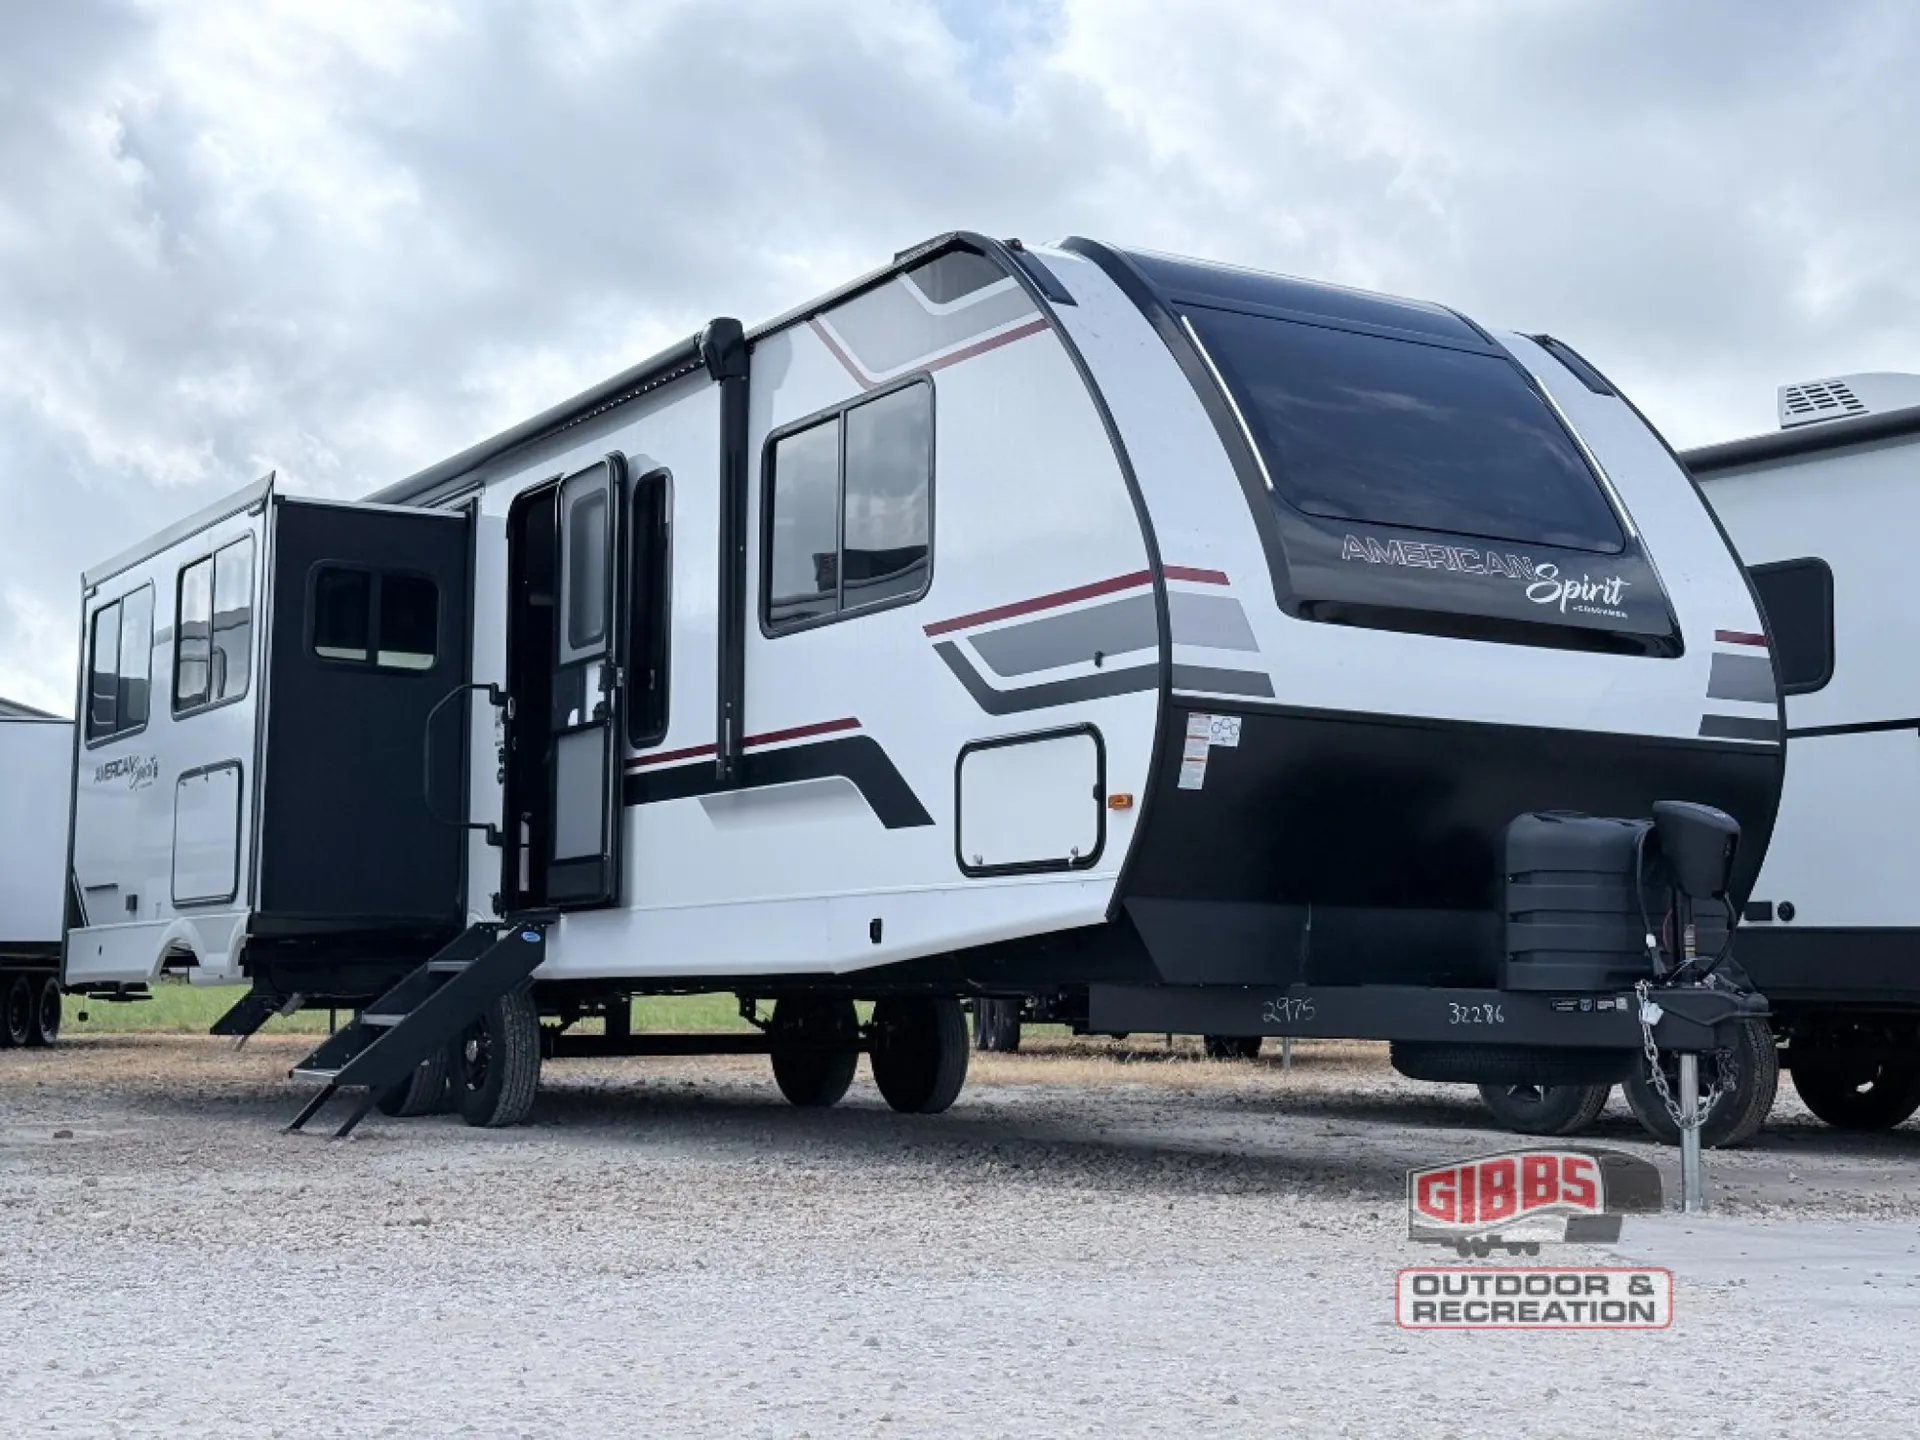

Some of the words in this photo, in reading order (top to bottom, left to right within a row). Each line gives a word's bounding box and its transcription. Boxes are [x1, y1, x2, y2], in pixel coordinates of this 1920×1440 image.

[1342, 534, 1537, 581] AMERICAN
[1526, 562, 1630, 613] Spirit
[1262, 997, 1316, 1023] 2975
[1449, 1002, 1505, 1025] 32286
